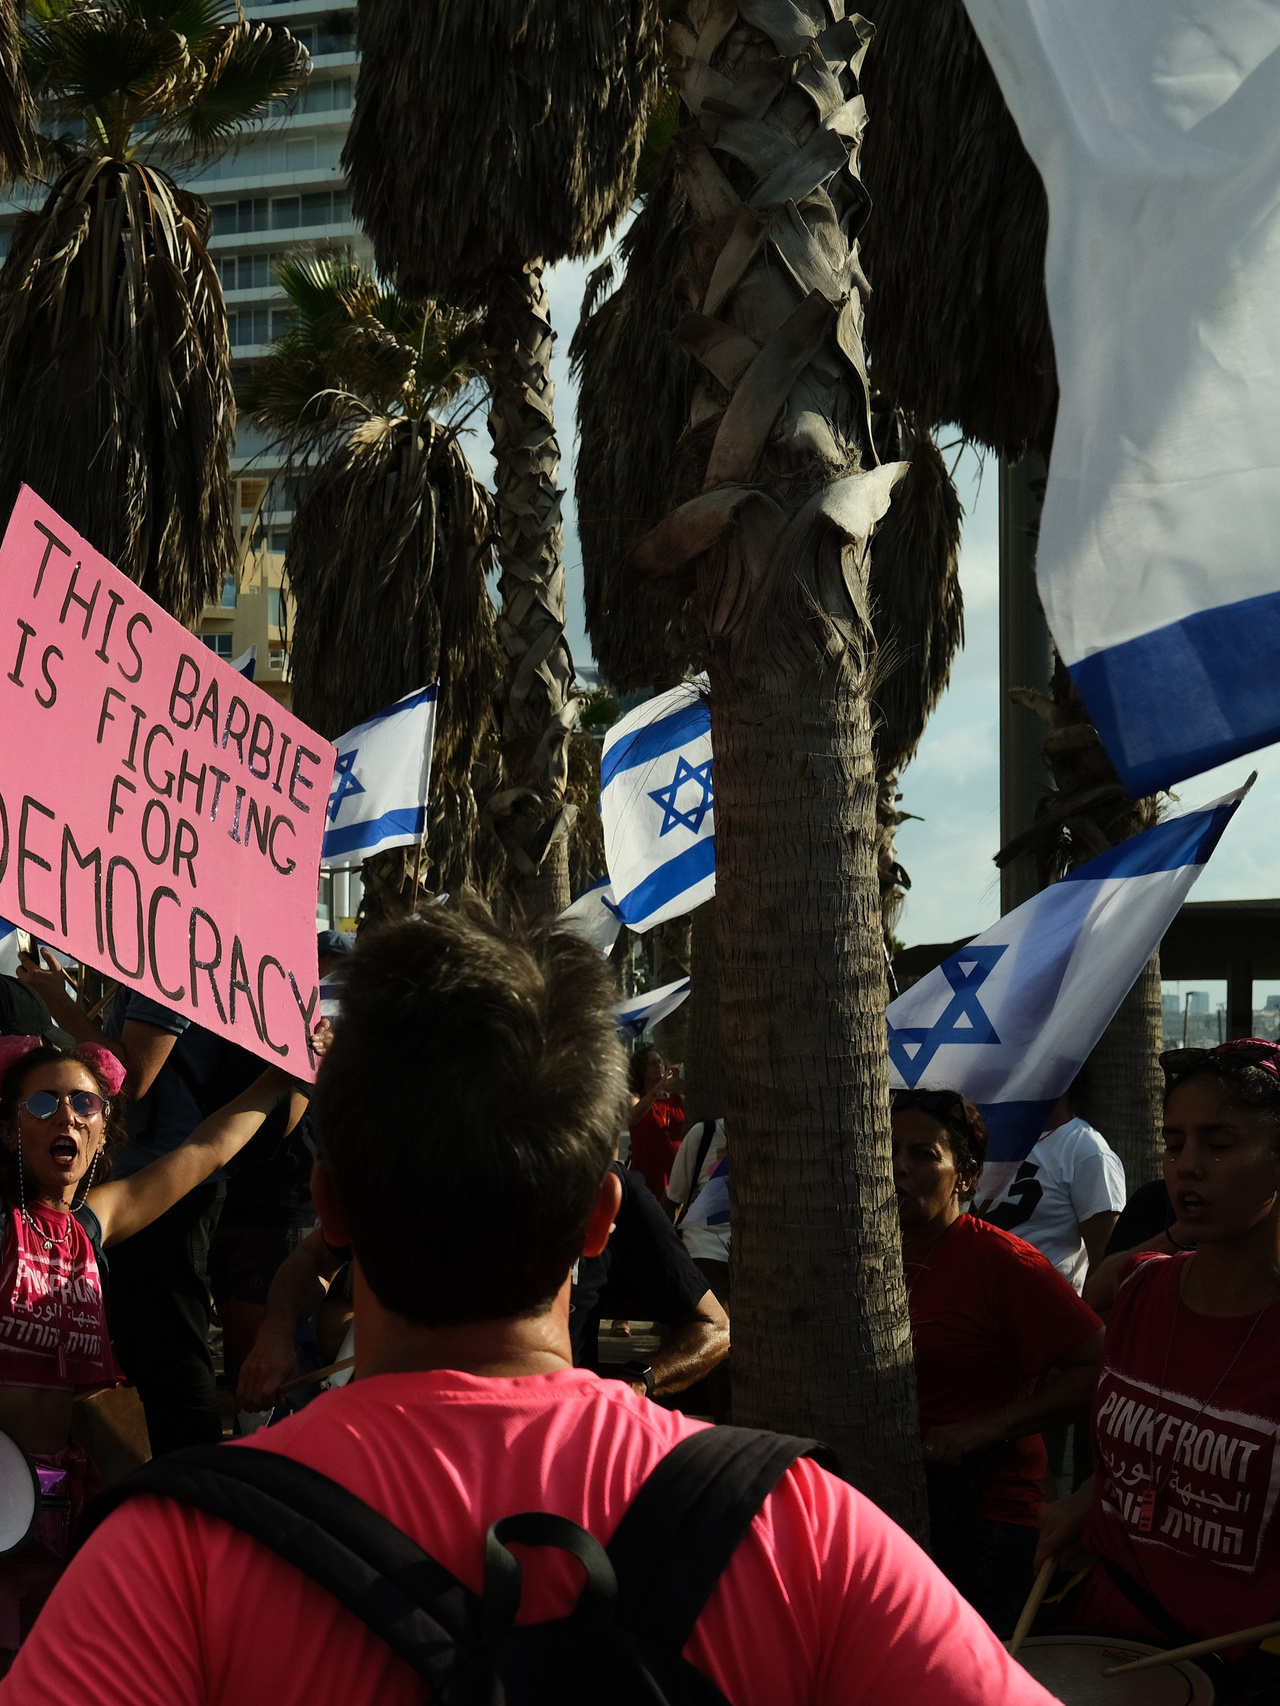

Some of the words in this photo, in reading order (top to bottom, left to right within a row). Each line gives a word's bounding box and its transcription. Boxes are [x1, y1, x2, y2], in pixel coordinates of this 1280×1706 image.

[33, 519, 154, 683] THIS
[168, 652, 323, 814] BARBIE
[7, 617, 65, 709] IS
[96, 686, 297, 876] FIGHTING
[107, 773, 200, 888] FOR
[1097, 1390, 1261, 1484] PINKFRONT
[1160, 1505, 1244, 1556] החזית
[1168, 1468, 1251, 1515] الجبهة
